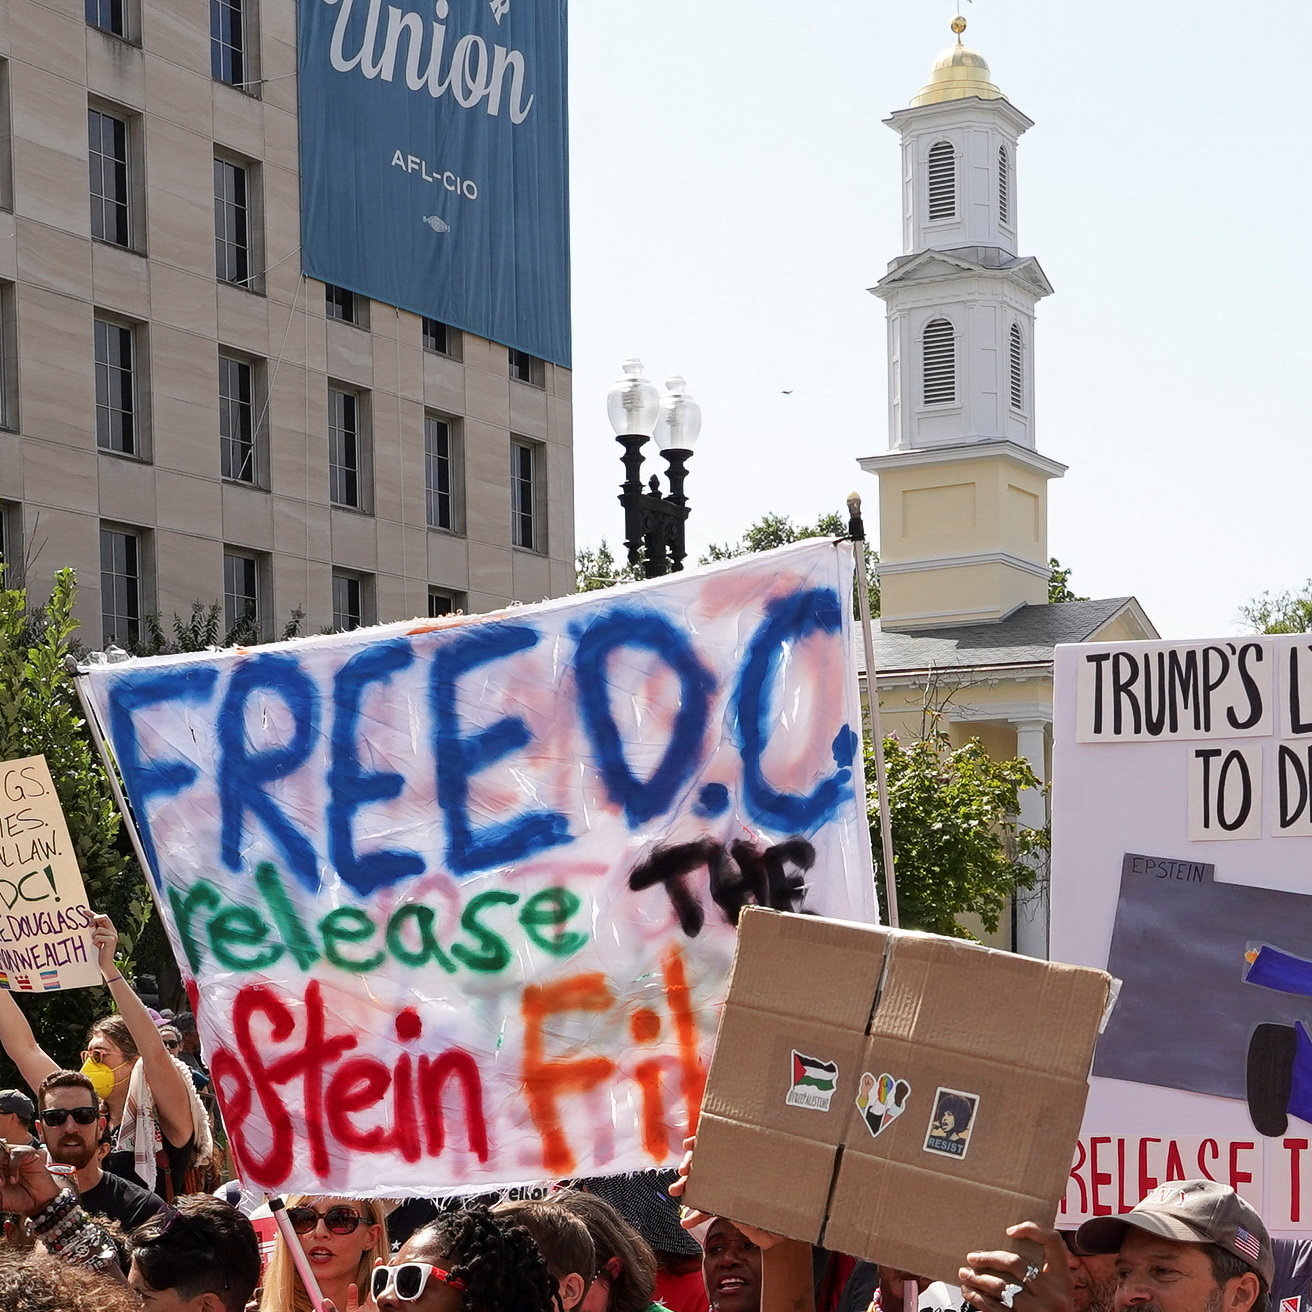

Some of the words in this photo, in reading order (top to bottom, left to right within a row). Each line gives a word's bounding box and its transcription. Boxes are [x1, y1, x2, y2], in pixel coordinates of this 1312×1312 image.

[323, 0, 534, 125] Union
[391, 149, 479, 201] AFL-CIO
[1086, 642, 1264, 736] TRUMP'S
[108, 620, 576, 894] FREE
[1194, 748, 1253, 832] TO
[16, 830, 63, 866] LAW.
[1132, 857, 1205, 884] EPSTEIN
[7, 904, 90, 942] DOUGLASS
[168, 860, 591, 975] release
[629, 837, 819, 937] THE
[520, 944, 706, 1175] Fil
[928, 1137, 964, 1154] RESIST
